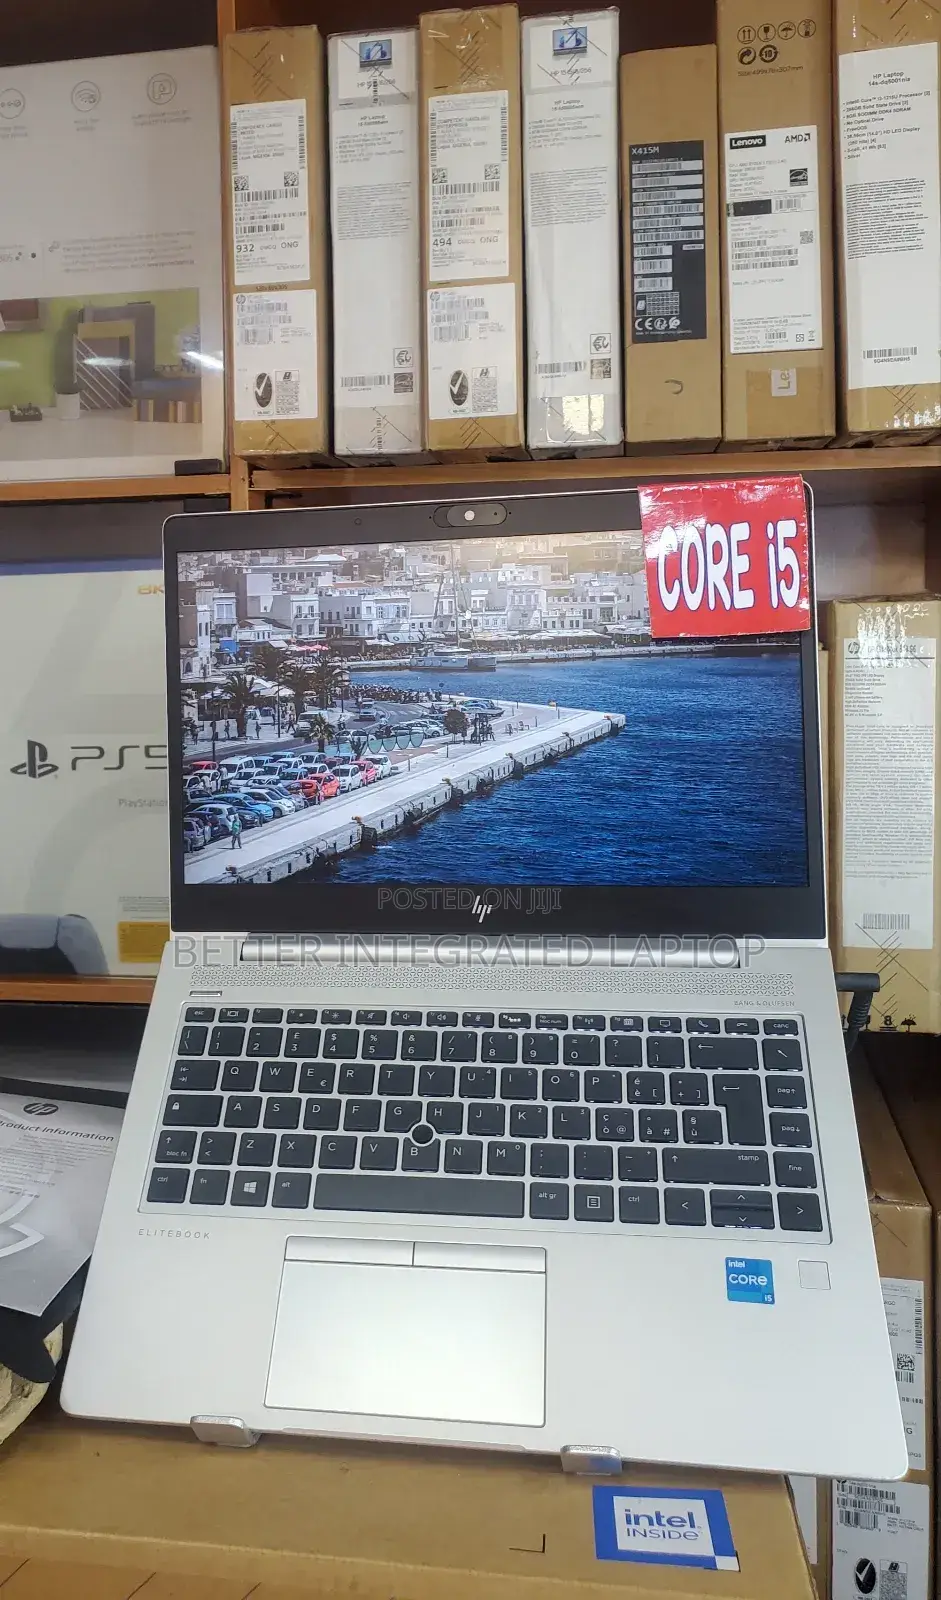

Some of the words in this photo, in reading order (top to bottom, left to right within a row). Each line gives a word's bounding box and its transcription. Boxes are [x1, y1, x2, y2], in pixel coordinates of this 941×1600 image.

[732, 138, 764, 148] Lenovo
[784, 135, 804, 144] AMD
[632, 146, 660, 156] X415M
[432, 238, 452, 246] 494
[236, 244, 254, 253] 932
[657, 522, 755, 612] CORE
[766, 519, 800, 609] i5
[471, 895, 492, 923] hp
[331, 1032, 337, 1041] $
[369, 1046, 375, 1054] 5
[489, 1048, 496, 1056] 8
[530, 1050, 537, 1058] 9
[230, 1066, 240, 1075] Q
[270, 1067, 282, 1076] W
[307, 1068, 314, 1077] E
[346, 1069, 354, 1078] R
[386, 1070, 393, 1079] T
[427, 1071, 435, 1080] Y
[468, 1072, 475, 1081] U
[550, 1075, 560, 1084] O
[592, 1077, 600, 1085] P
[273, 1103, 280, 1112] S
[312, 1104, 320, 1113] D
[352, 1105, 360, 1114] F
[394, 1106, 402, 1115] G
[434, 1108, 442, 1116] H
[476, 1110, 482, 1118] J
[518, 1111, 526, 1120] K
[561, 1113, 568, 1122] L
[42, 1126, 114, 1142] Information
[616, 1125, 626, 1134] @
[247, 1140, 255, 1148] Z
[287, 1141, 296, 1150] X
[328, 1142, 336, 1151] C
[370, 1144, 378, 1152] V
[411, 1148, 418, 1156] B
[453, 1147, 462, 1155] N
[496, 1148, 506, 1157] M
[138, 1228, 211, 1239] ELITEBOOK
[728, 1260, 746, 1268] intel
[624, 1508, 697, 1529] intel
